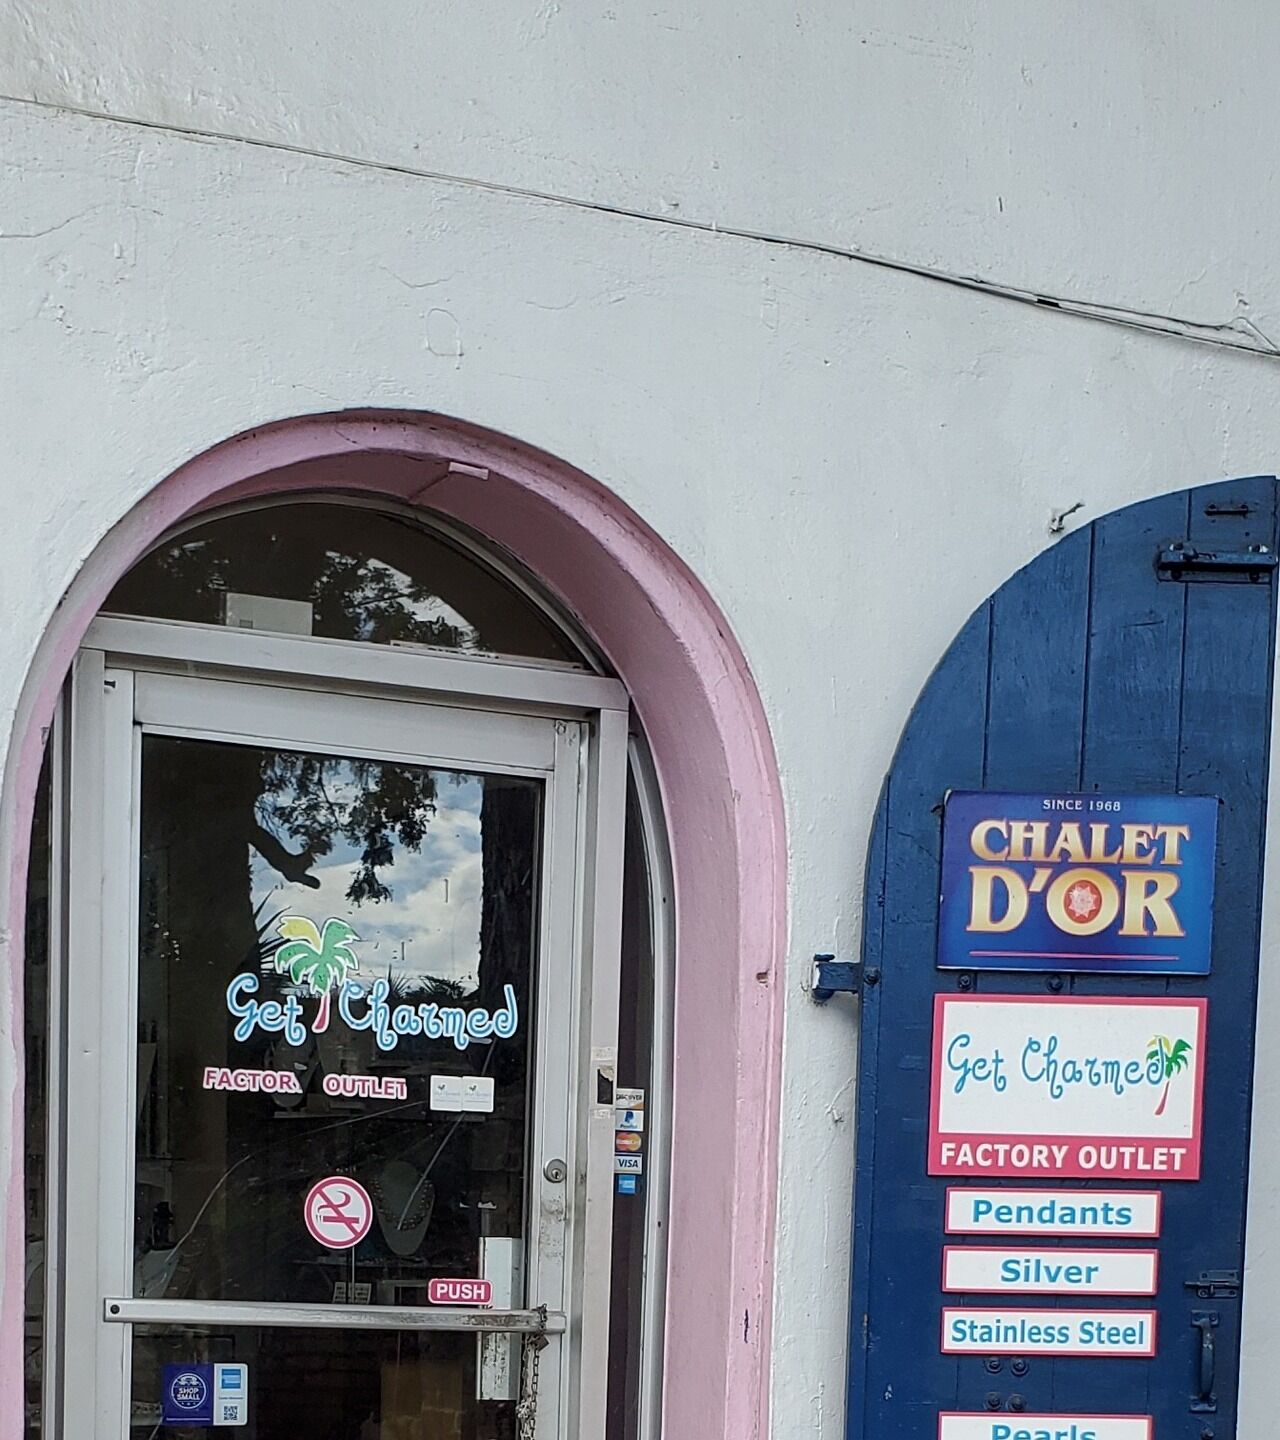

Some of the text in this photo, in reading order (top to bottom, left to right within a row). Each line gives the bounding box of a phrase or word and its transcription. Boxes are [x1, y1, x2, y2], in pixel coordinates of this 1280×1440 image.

[1043, 798, 1121, 812] SINCE 1968
[969, 818, 1191, 865] CHALET
[965, 864, 1186, 937] D'OR
[226, 972, 518, 1050] Get Charmed
[946, 1033, 1165, 1099] Get Charmed
[324, 1074, 407, 1099] OUTLET
[618, 1159, 638, 1168] VISA
[941, 1142, 1187, 1171] FACTORY OUTLET
[972, 1199, 1132, 1225] Pendants
[1000, 1258, 1099, 1284] Silver
[436, 1283, 485, 1301] PUSH
[951, 1318, 1144, 1345] Stainless Steel
